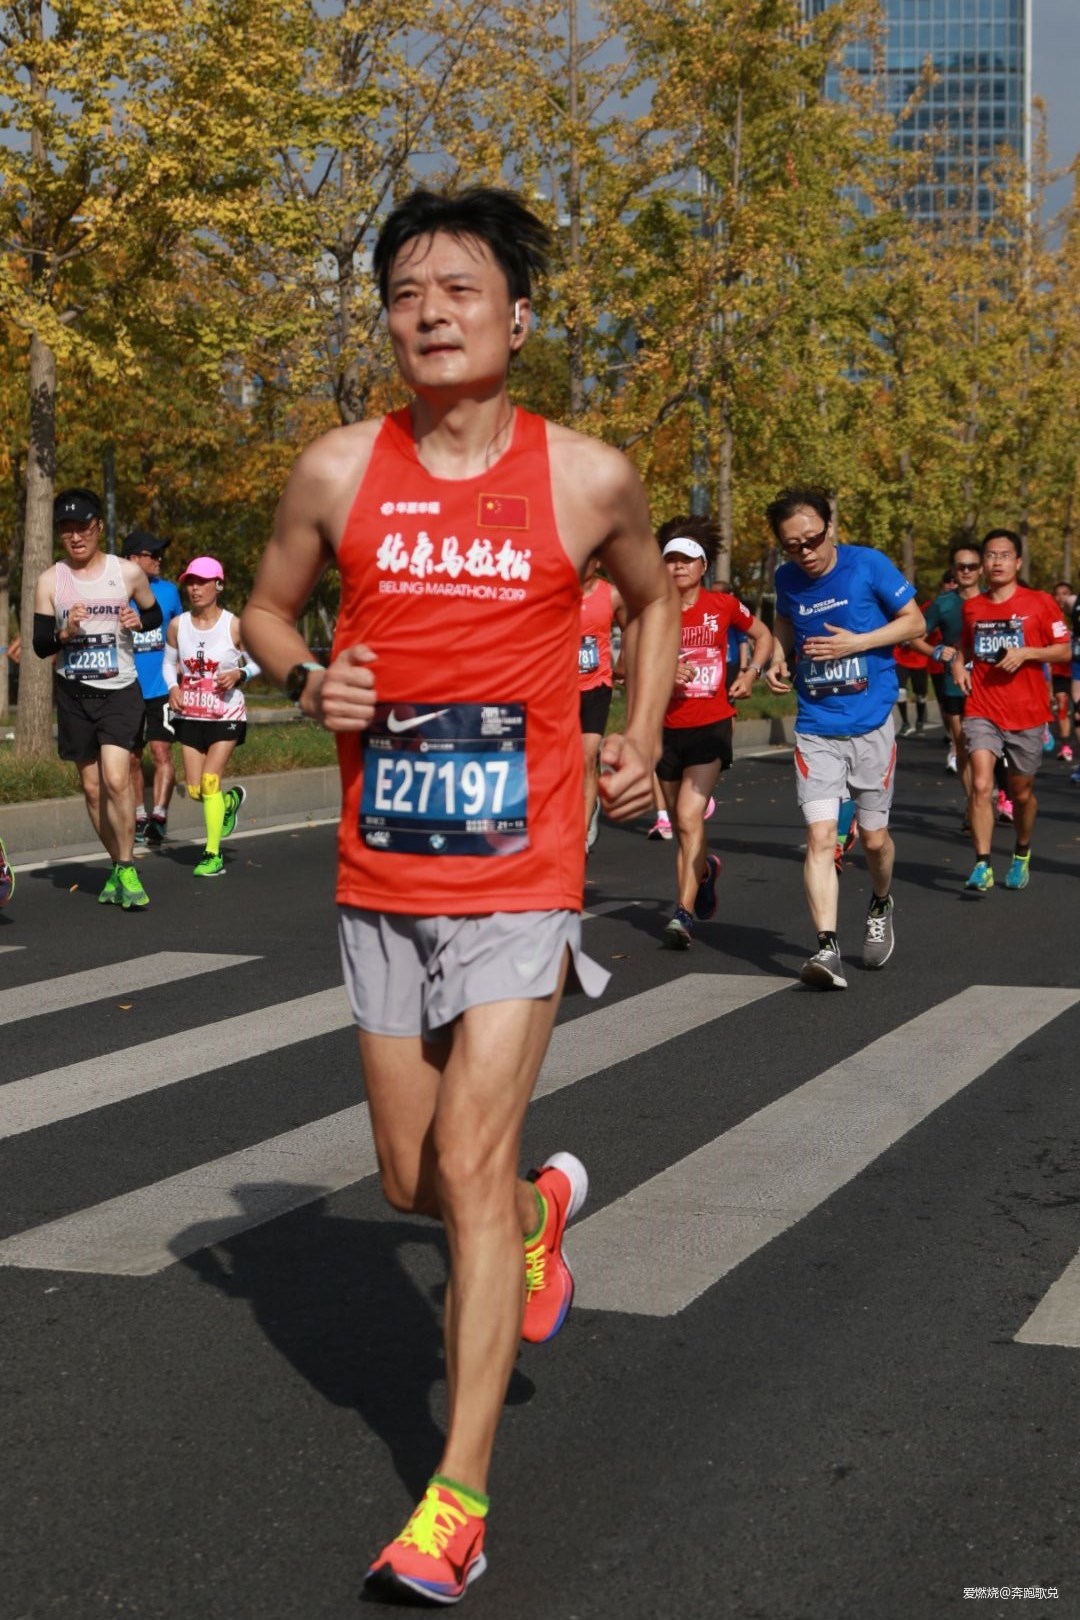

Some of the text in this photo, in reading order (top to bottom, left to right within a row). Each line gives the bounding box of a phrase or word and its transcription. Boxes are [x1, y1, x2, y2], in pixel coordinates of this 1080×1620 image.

[378, 580, 527, 601] BEIJING MARATHON 2019
[133, 628, 163, 645] 25296
[68, 650, 113, 670] C22281
[693, 665, 718, 685] 287
[375, 758, 509, 816] E27197
